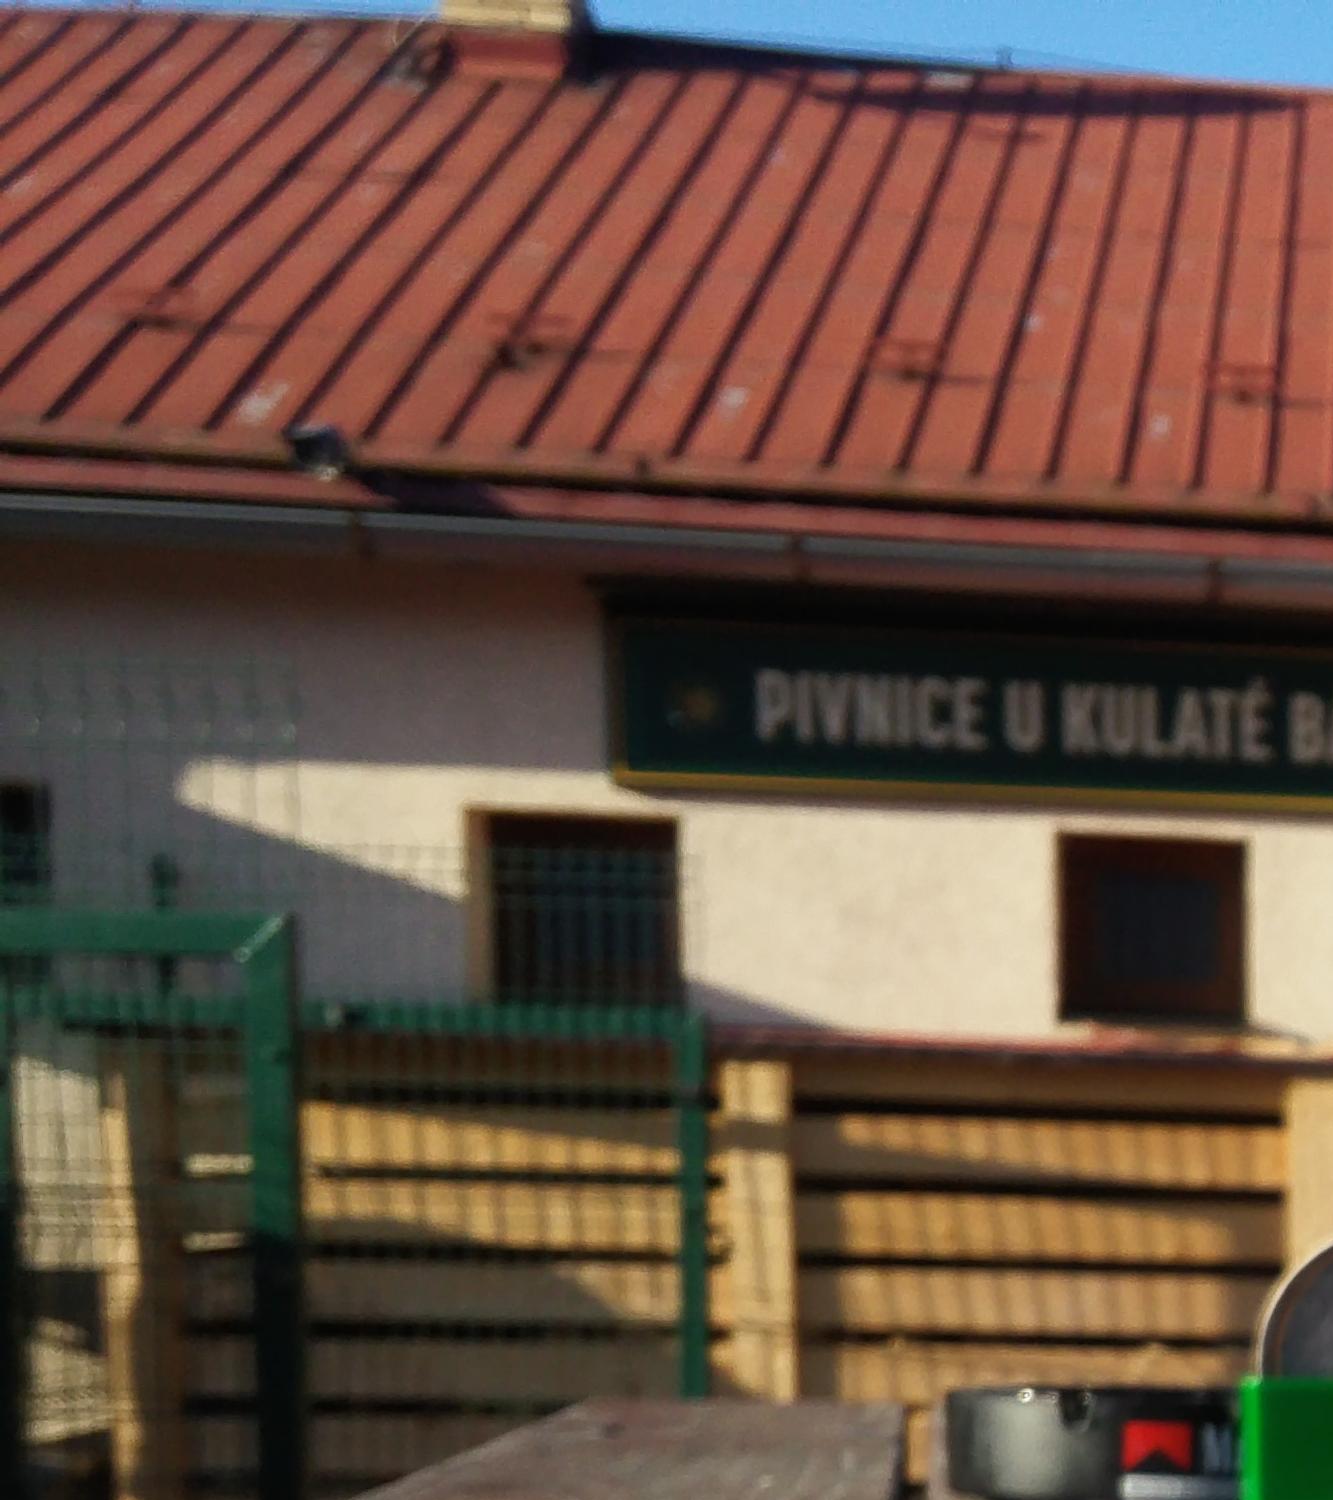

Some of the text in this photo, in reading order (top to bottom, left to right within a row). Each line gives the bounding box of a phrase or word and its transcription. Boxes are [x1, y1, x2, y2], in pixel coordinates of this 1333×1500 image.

[755, 667, 990, 750] PIVNICE
[1003, 678, 1046, 752] U
[1060, 674, 1275, 762] KULATÉ
